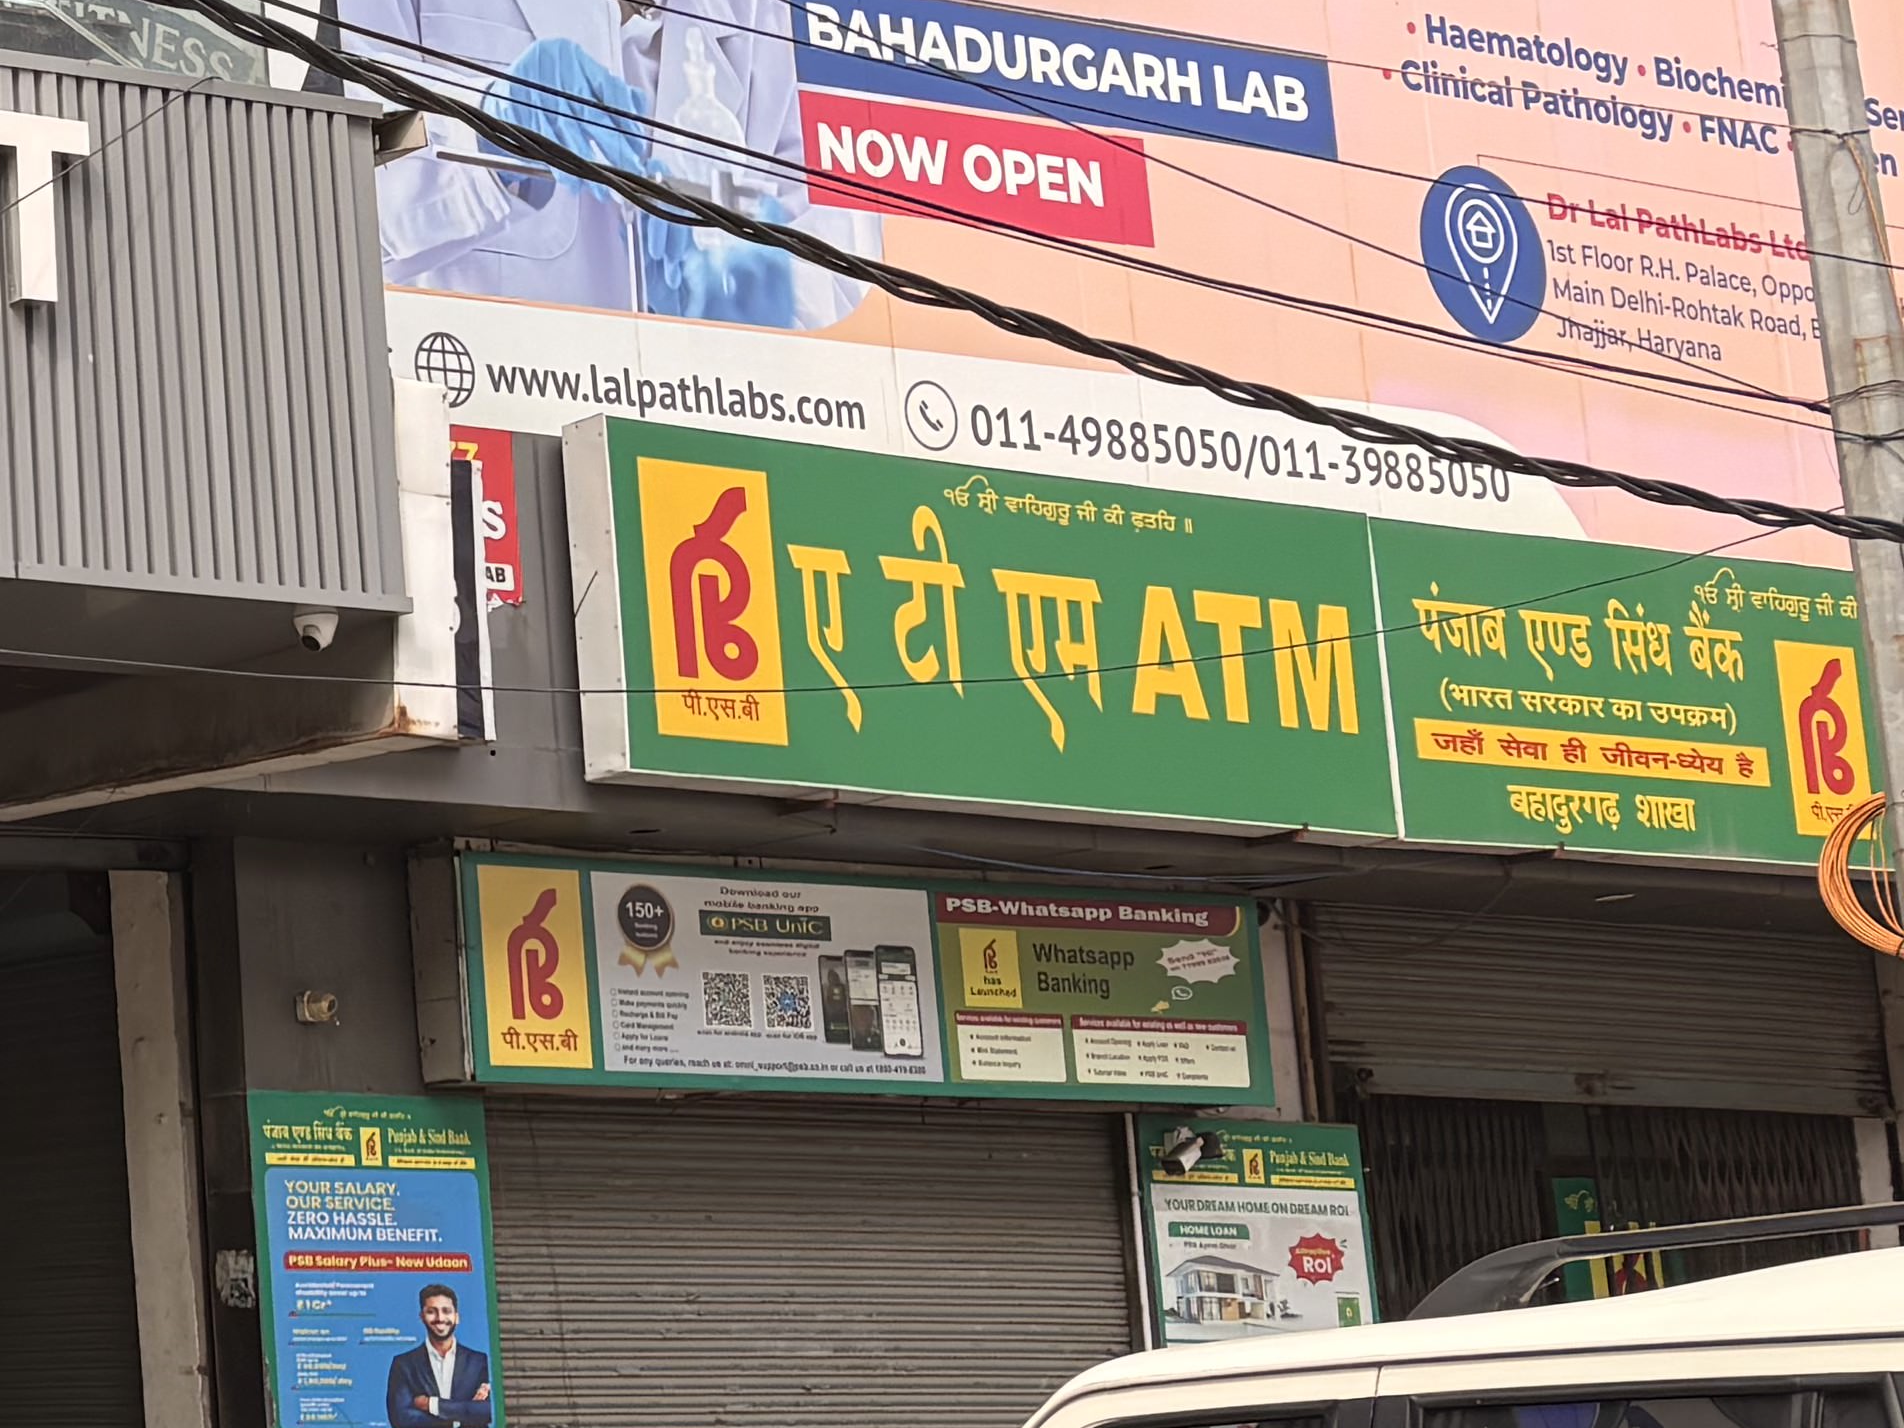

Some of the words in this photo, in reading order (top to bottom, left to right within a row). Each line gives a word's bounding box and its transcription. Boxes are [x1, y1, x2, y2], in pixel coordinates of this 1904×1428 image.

[806, 2, 1203, 107] BAHADURGARH
[1212, 65, 1309, 122] LAB
[1424, 13, 1628, 87] Haematology
[1653, 56, 1783, 109] Biochem
[1401, 59, 1513, 109] Clinical
[1523, 81, 1673, 143] Pathology
[1699, 115, 1780, 155] FNAC
[817, 121, 948, 186] NOW
[963, 142, 1104, 208] OPEN
[1547, 193, 1580, 223] Dr
[1588, 200, 1629, 234] Lal
[1637, 208, 1763, 255] PathLabs
[1548, 240, 1576, 265] 1st
[1581, 245, 1634, 274] Floor
[1640, 256, 1680, 282] R.H.
[1686, 265, 1757, 297] Palace,
[1554, 278, 1605, 307] Main
[1612, 285, 1744, 329] Delhi-Rohtak
[1751, 315, 1807, 341] Road,
[1557, 317, 1634, 352] Jhajjar,
[1638, 329, 1722, 361] Haryana
[487, 362, 866, 430] www.lalpathlabs.com
[971, 403, 1510, 502] 011-49885050/011-39885050
[787, 543, 862, 736] ए
[878, 505, 965, 698] टी
[992, 568, 1103, 753] एम
[1131, 585, 1360, 736] ATM
[1412, 582, 1507, 659] पंजाब
[1519, 609, 1592, 682] एण्ड
[1604, 598, 1672, 676] सिंध
[1683, 602, 1744, 682] बैंक
[681, 690, 760, 724] पी.एस.बी
[1439, 677, 1513, 712] (भारत
[1520, 691, 1605, 719] सरकार
[1611, 697, 1643, 723] का
[1649, 701, 1738, 736] उपक्रम)
[1431, 728, 1485, 756] जहाँ
[1497, 731, 1548, 760] सेवा
[1561, 737, 1587, 764] ही
[1738, 750, 1755, 779] है
[1506, 784, 1621, 834] बहादुरगढ़
[1635, 794, 1696, 832] शाखा
[625, 901, 665, 920] 150+
[946, 897, 1113, 923] PSB-Whatsapp
[1118, 906, 1210, 927] Banking
[1032, 942, 1135, 971] Whatsapp
[1037, 972, 1110, 1000] Banking
[501, 1028, 579, 1054] पी.एस.बी
[284, 1180, 332, 1195] YOUR
[334, 1182, 400, 1196] SALARY.
[286, 1196, 321, 1209] OUR
[325, 1197, 395, 1211] SERVICE.
[1164, 1198, 1196, 1212] YOUR
[1197, 1200, 1235, 1213] DREAM
[1237, 1201, 1270, 1214] HOME
[1289, 1202, 1328, 1216] DREAM
[287, 1211, 330, 1225] ZERO
[333, 1213, 397, 1227] HASSLE.
[288, 1227, 373, 1241] MAXIMUM
[376, 1229, 442, 1243] BENEFIT.
[1179, 1225, 1208, 1236] HOME
[315, 1255, 357, 1270] Salary
